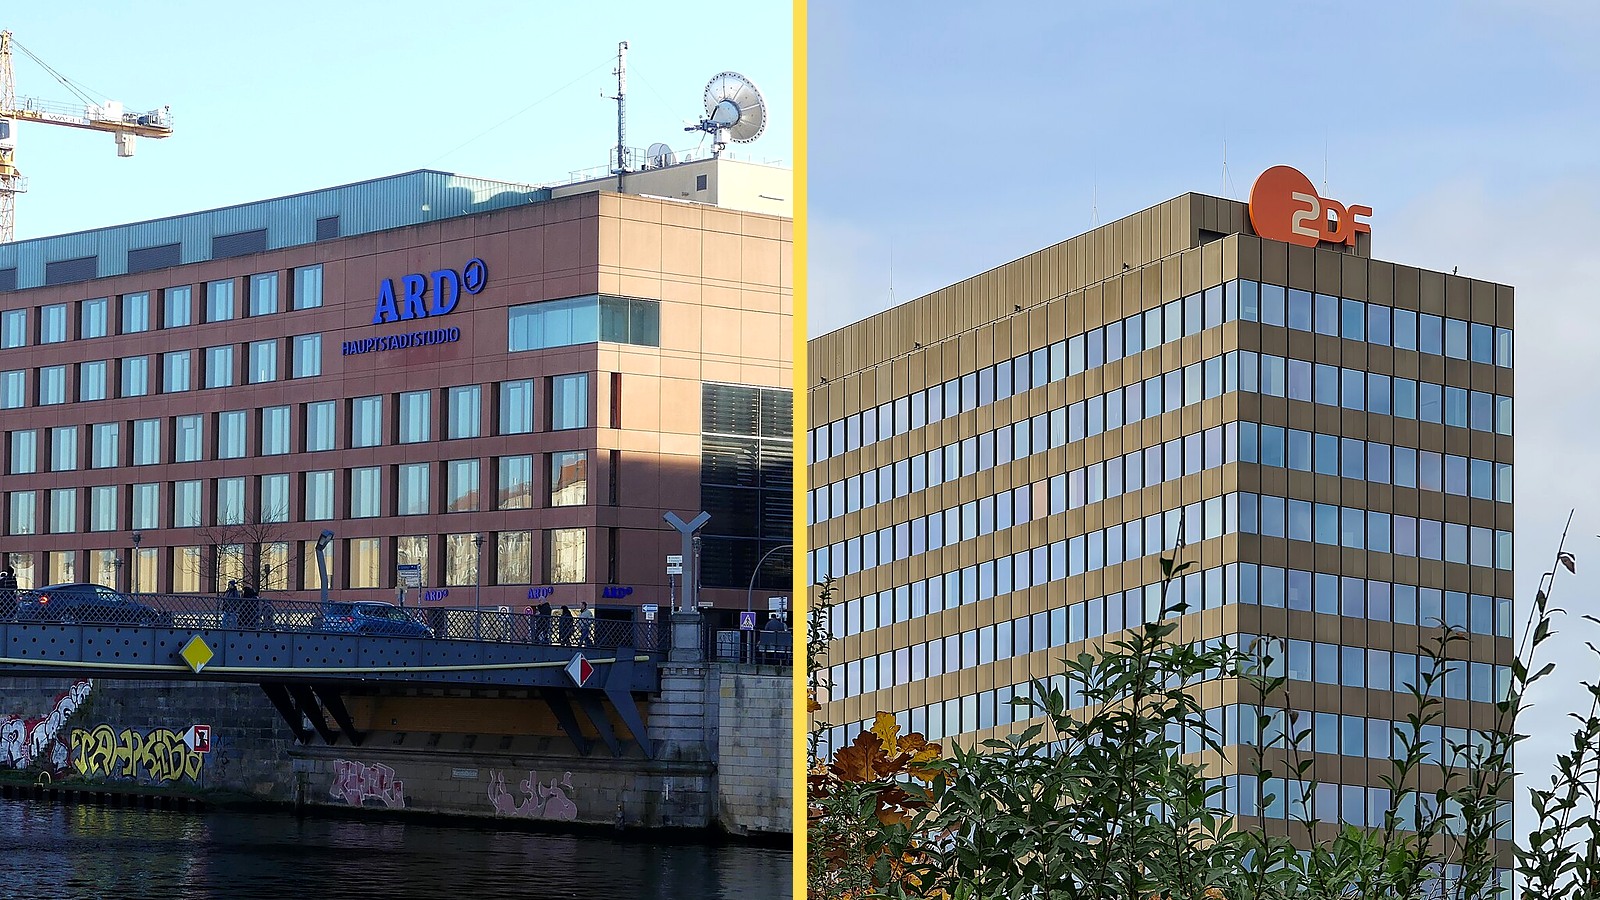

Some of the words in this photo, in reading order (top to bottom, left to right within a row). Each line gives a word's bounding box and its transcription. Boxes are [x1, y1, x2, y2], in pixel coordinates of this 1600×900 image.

[372, 268, 461, 325] ARD
[342, 326, 460, 356] HAUPTSTADTSTUDIO
[424, 590, 443, 602] ARD
